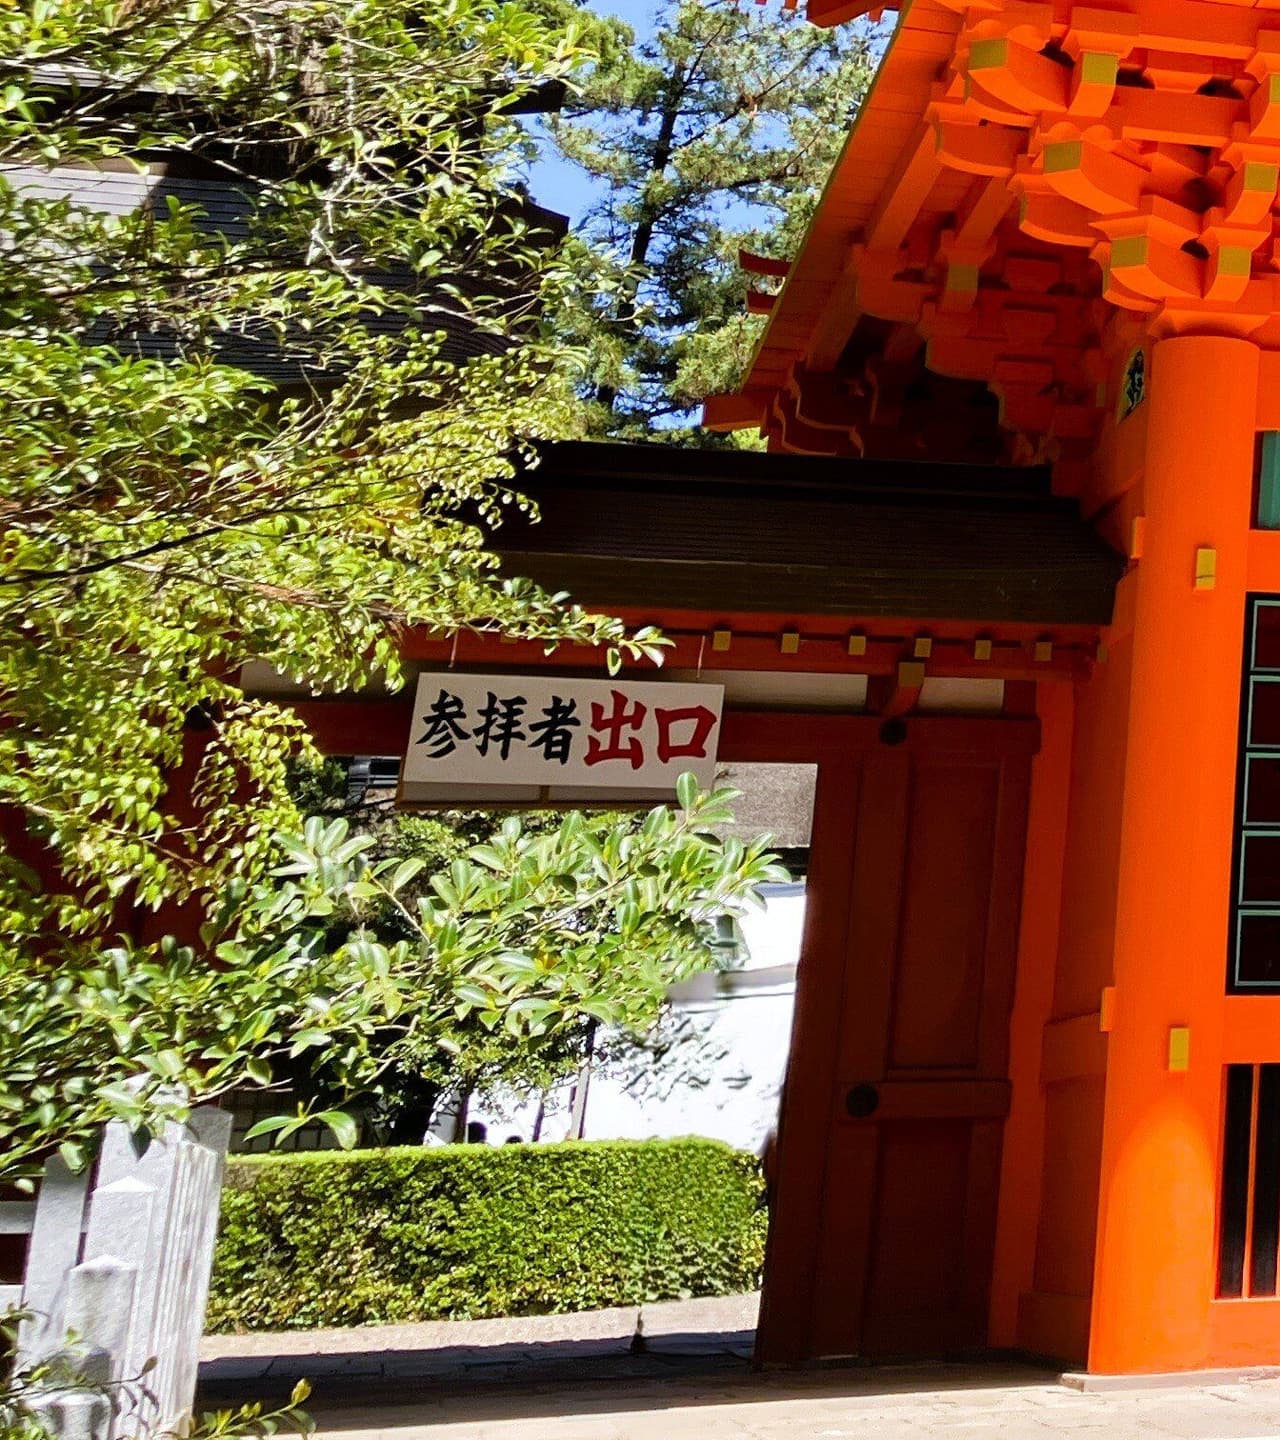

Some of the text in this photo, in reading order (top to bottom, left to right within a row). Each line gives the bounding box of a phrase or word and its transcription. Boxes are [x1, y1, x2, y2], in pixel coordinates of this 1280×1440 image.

[415, 688, 718, 770] 参拝者出口
